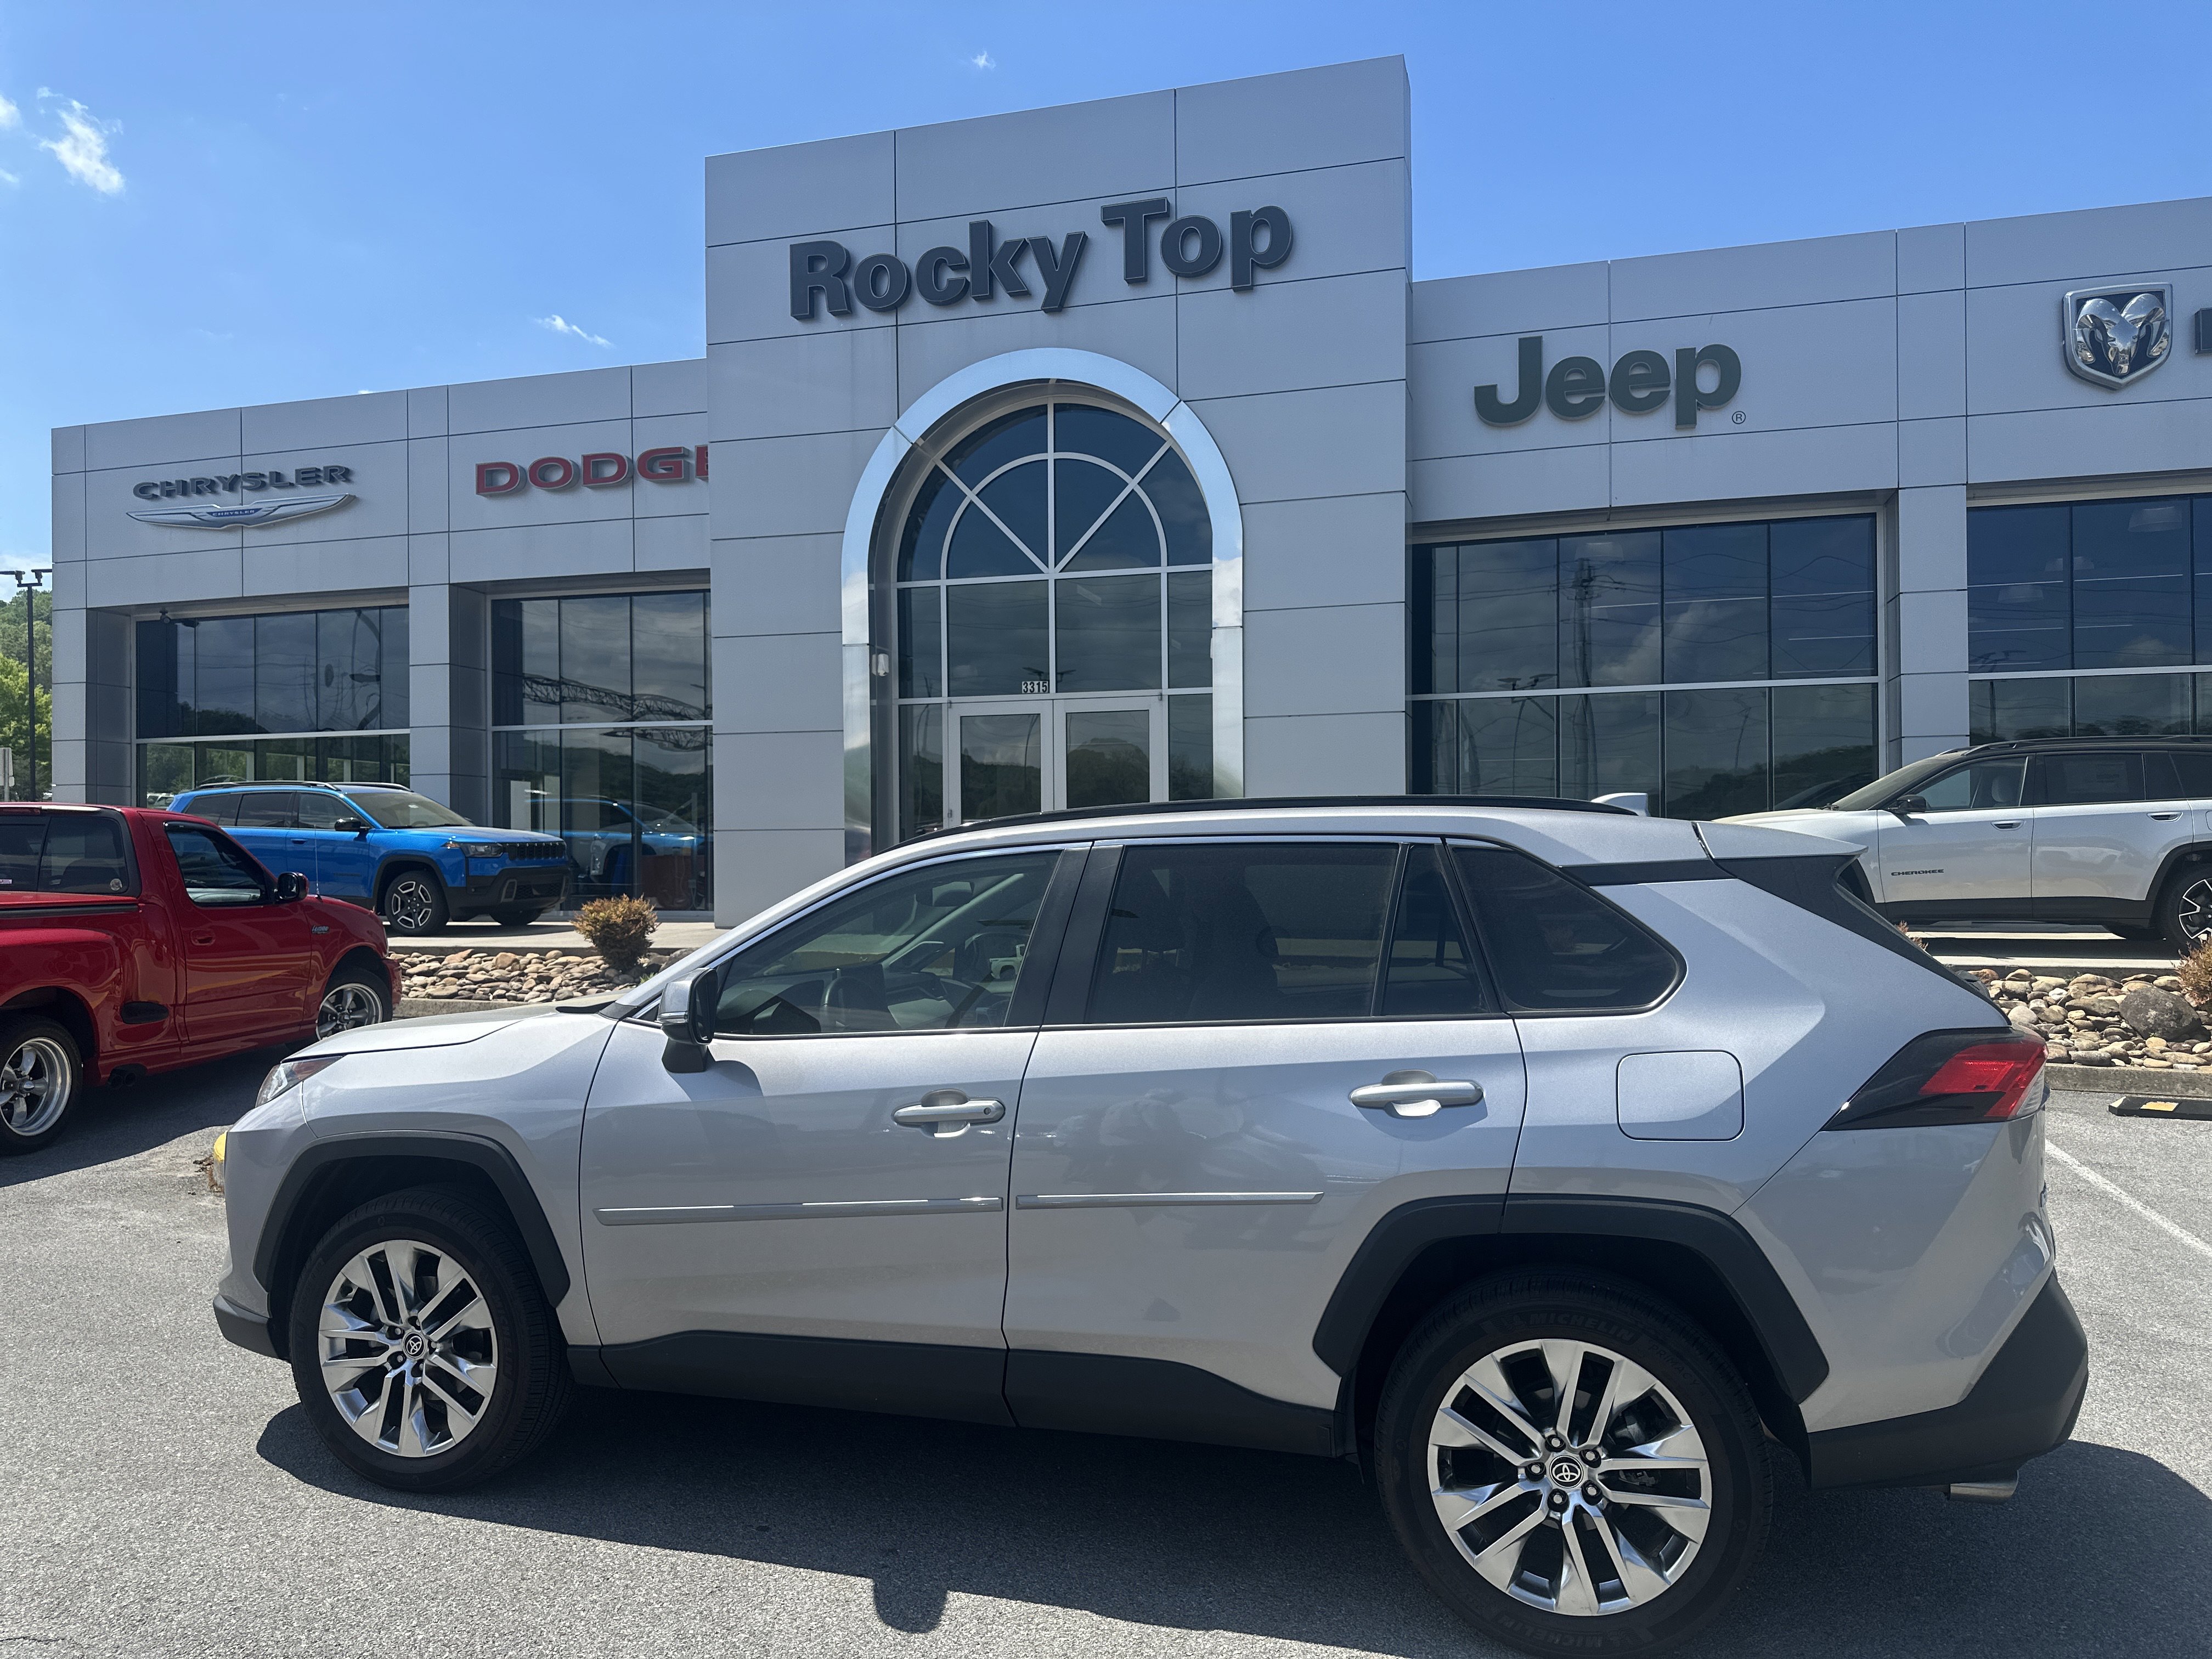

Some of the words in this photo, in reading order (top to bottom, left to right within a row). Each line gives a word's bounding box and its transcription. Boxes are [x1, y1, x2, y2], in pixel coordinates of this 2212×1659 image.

[789, 219, 1088, 320] Rocky
[1100, 196, 1294, 292] Top
[1474, 335, 1742, 430] Jeep
[132, 465, 351, 499] CHRYSLER
[1022, 681, 1048, 693] 3315
[1530, 1312, 1636, 1341] MICHELIN
[1648, 1342, 1701, 1387] PRIMACY
